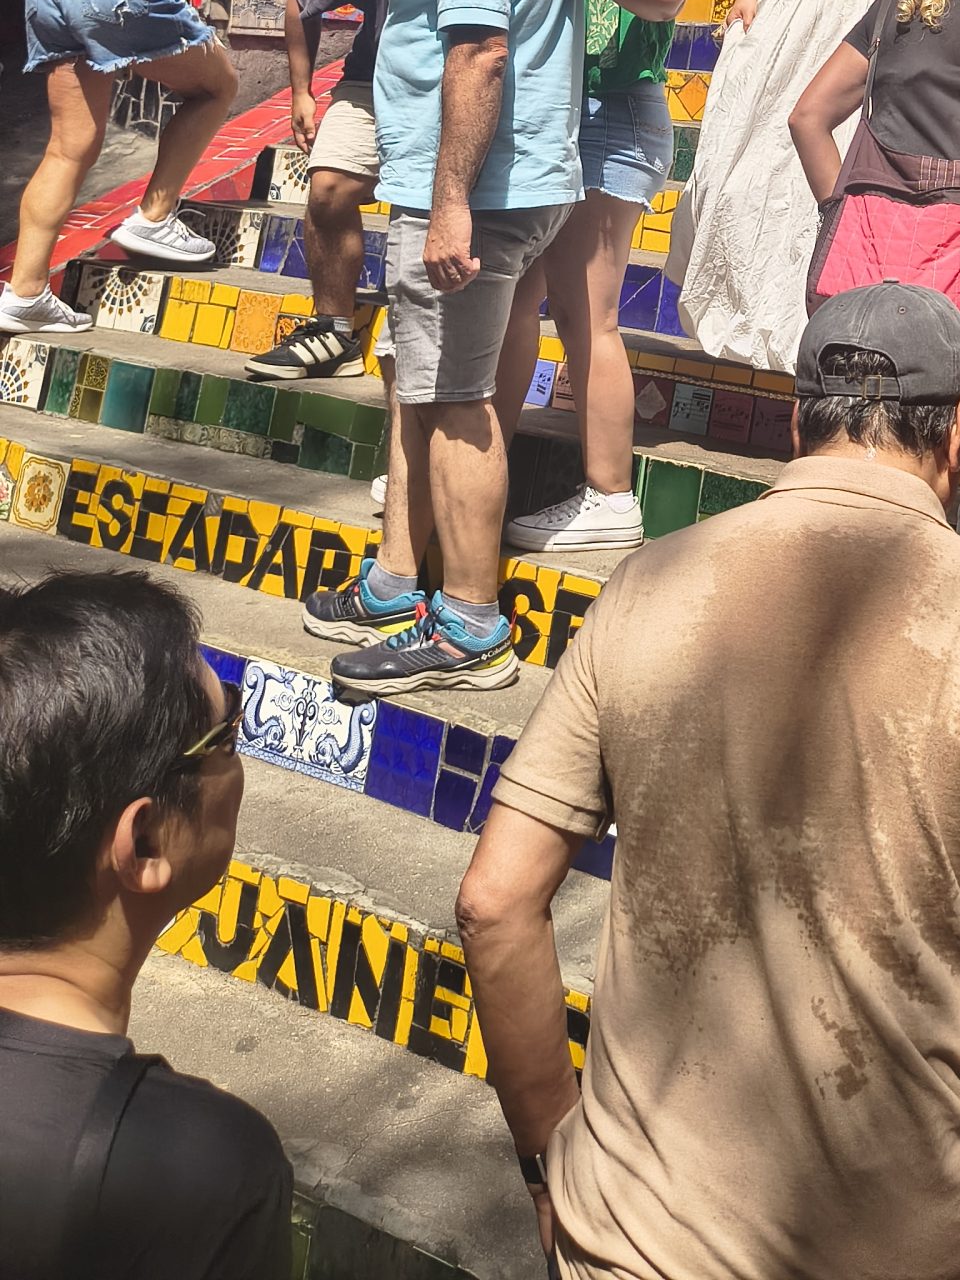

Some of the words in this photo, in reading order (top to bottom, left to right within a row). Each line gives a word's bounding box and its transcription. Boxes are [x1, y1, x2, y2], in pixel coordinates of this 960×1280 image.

[57, 470, 383, 603] ESCADAR
[498, 577, 596, 670] SE
[200, 882, 480, 1076] JANE
